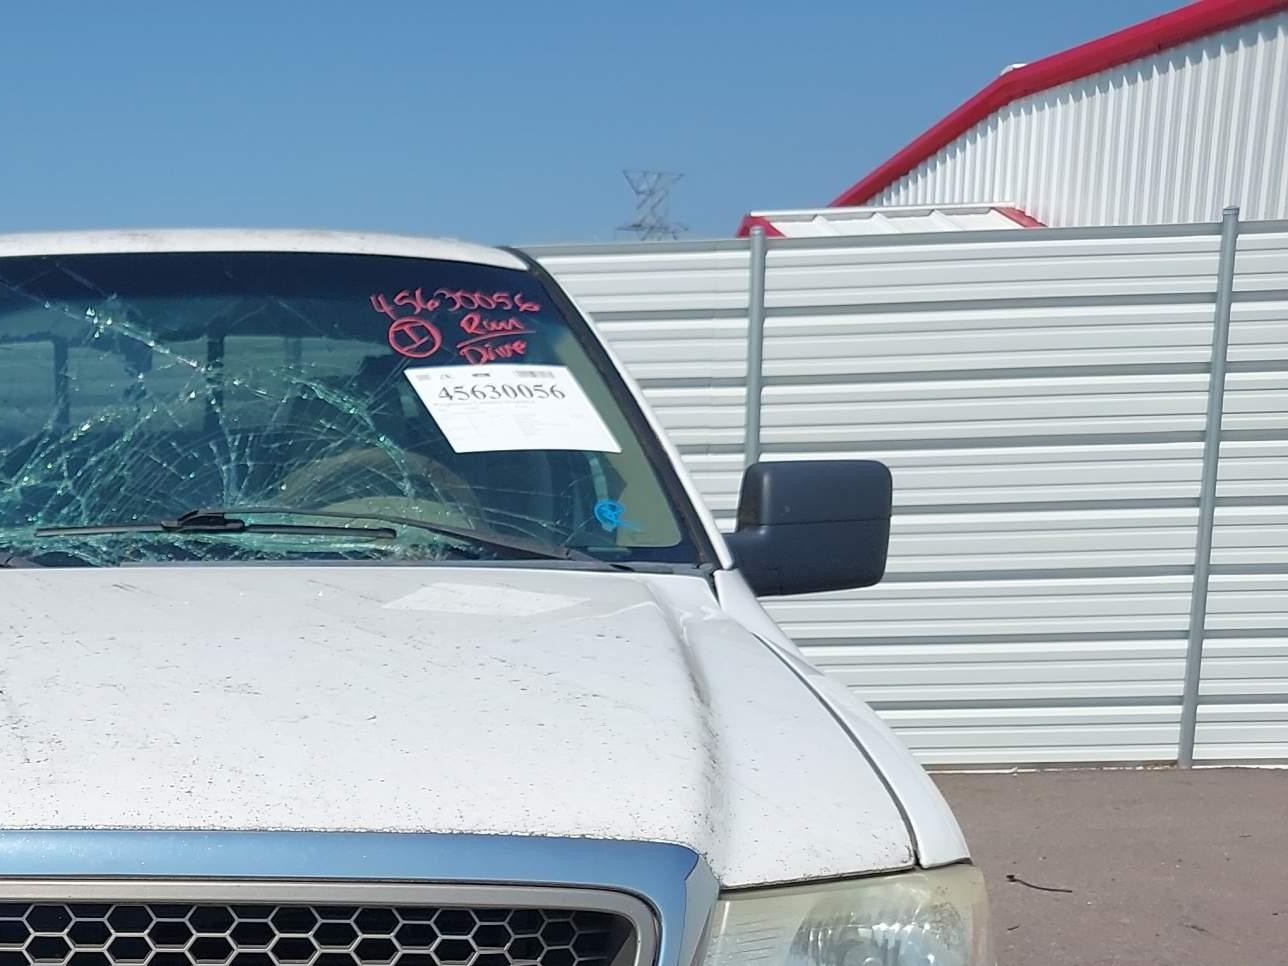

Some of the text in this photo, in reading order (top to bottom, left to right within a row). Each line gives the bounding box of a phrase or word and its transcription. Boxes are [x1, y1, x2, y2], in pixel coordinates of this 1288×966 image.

[369, 287, 541, 321] 45630056
[459, 311, 526, 336] Run
[438, 383, 566, 401] 45630056
